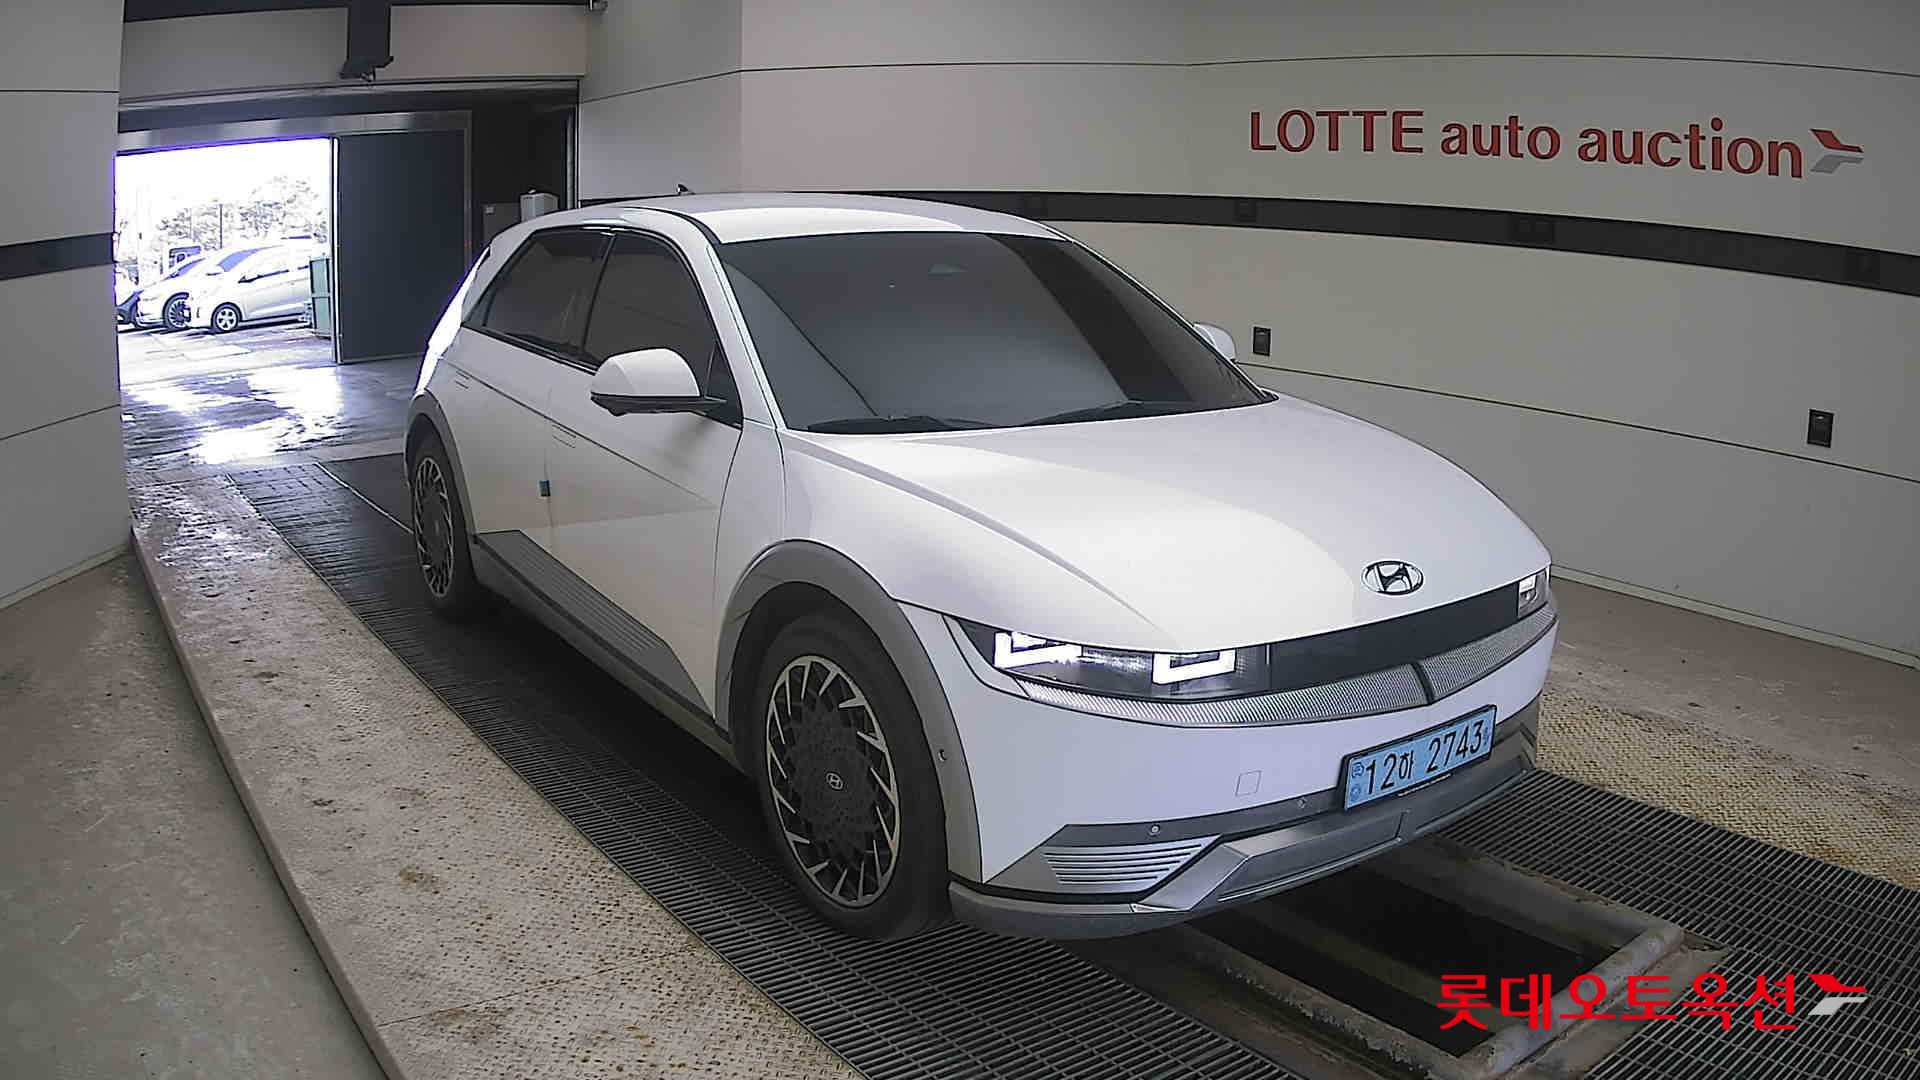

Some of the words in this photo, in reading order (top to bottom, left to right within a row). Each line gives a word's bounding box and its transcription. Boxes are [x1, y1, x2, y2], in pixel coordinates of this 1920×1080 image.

[1250, 110, 1424, 154] LOTTE
[1440, 115, 1561, 160] auto
[1577, 117, 1803, 178] auction
[1366, 750, 1415, 795] 12하
[1426, 719, 1484, 774] 2743
